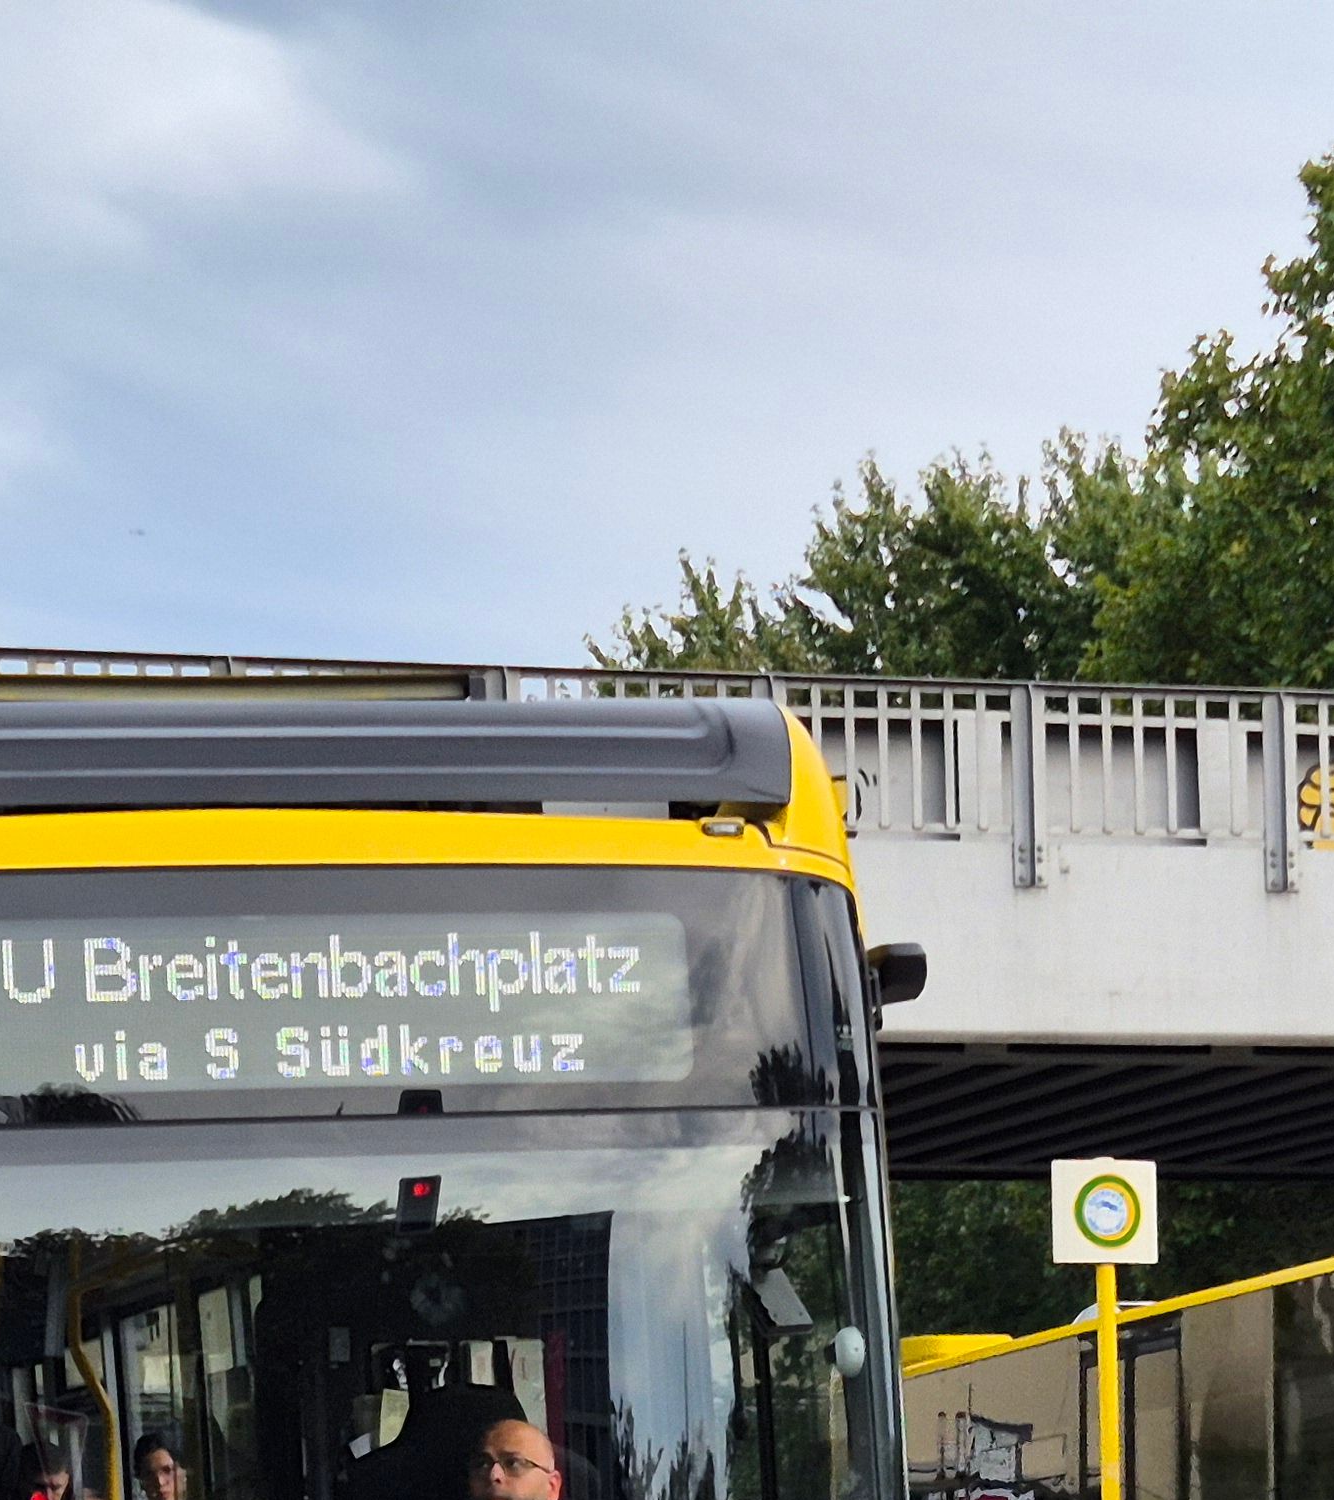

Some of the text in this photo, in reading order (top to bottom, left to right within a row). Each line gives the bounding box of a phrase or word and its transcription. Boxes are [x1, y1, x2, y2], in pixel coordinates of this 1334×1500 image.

[1, 937, 55, 1004] U
[82, 931, 642, 1012] Breitenbachplatz
[73, 1023, 586, 1083] via S Südkreuz
